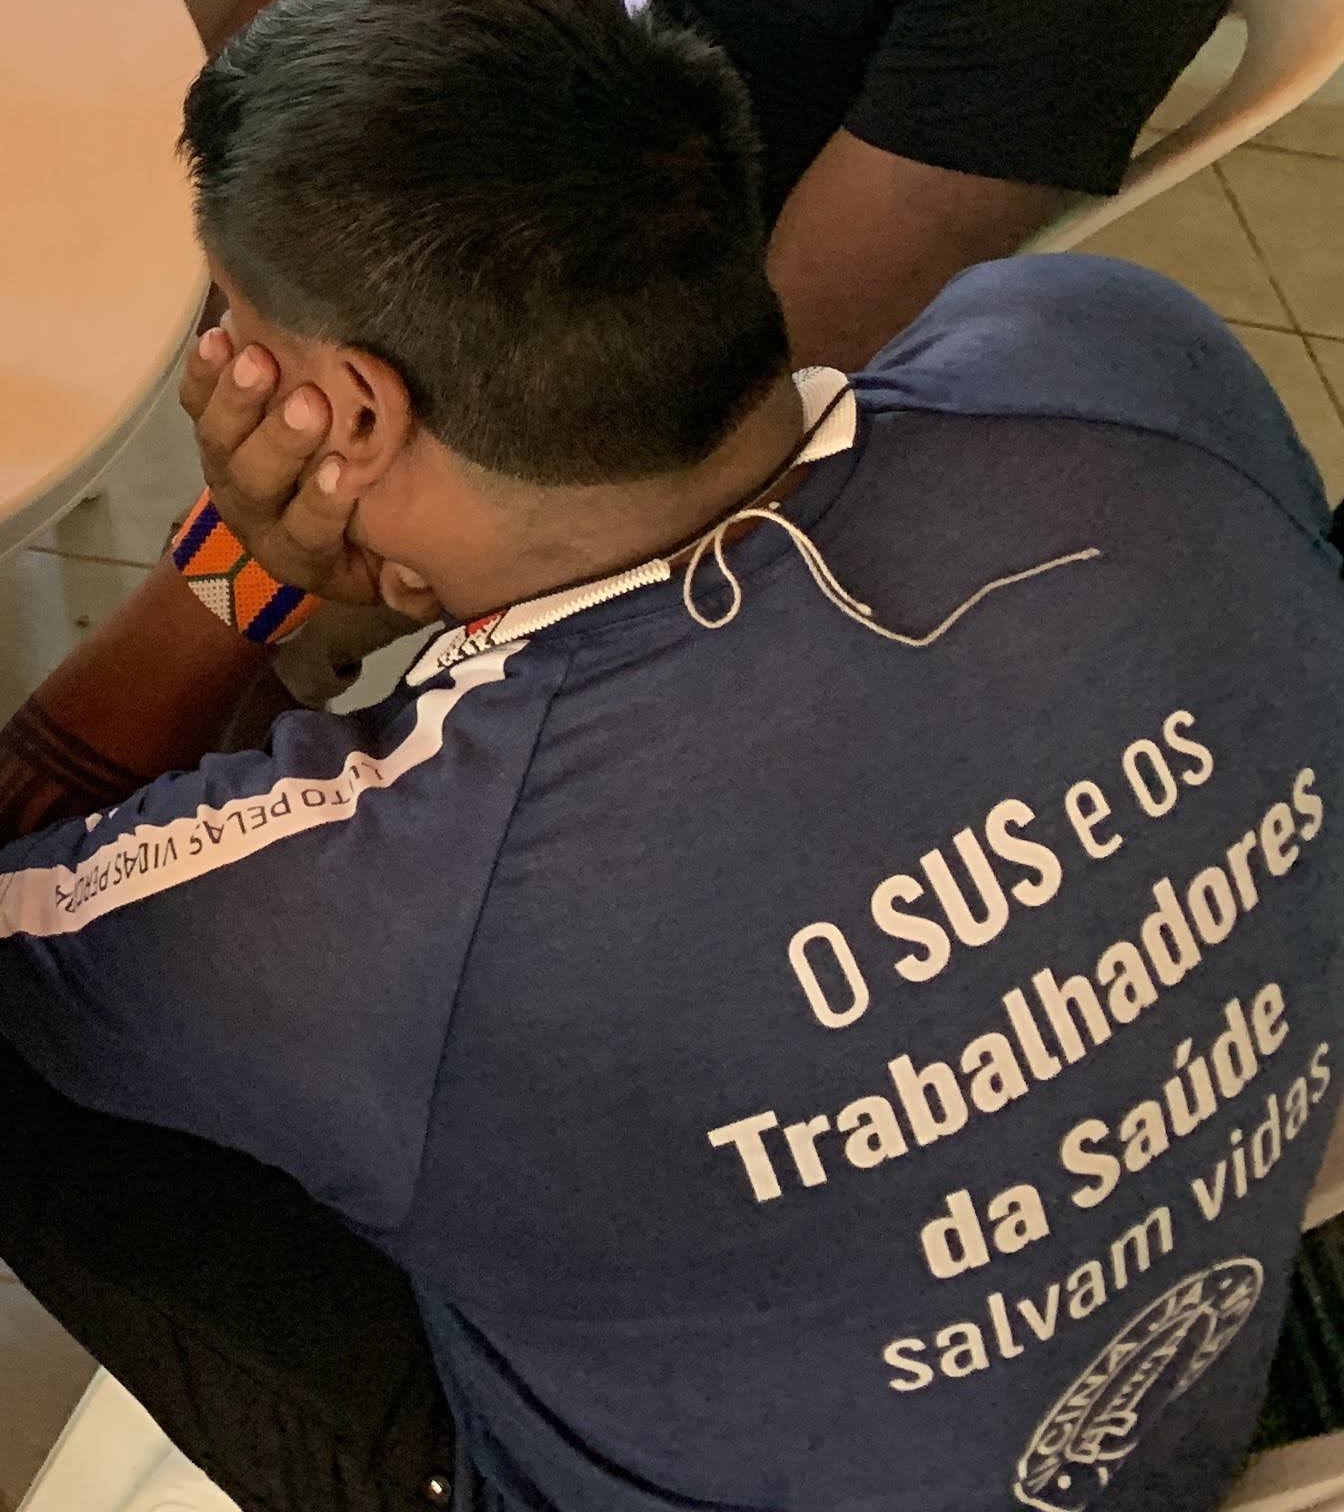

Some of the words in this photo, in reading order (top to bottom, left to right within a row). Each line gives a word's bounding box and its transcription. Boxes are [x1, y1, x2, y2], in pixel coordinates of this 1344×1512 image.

[112, 836, 178, 885] VIDAS
[188, 792, 291, 855] PELAS
[788, 921, 870, 1029] O
[870, 798, 1064, 984] SUS
[1064, 779, 1123, 861] e
[708, 766, 1326, 1205] Trabalhadores
[880, 1204, 1176, 1395] salvam
[1188, 1039, 1334, 1224] vidas
[919, 1189, 1051, 1281] da
[1057, 979, 1290, 1212] Saúde
